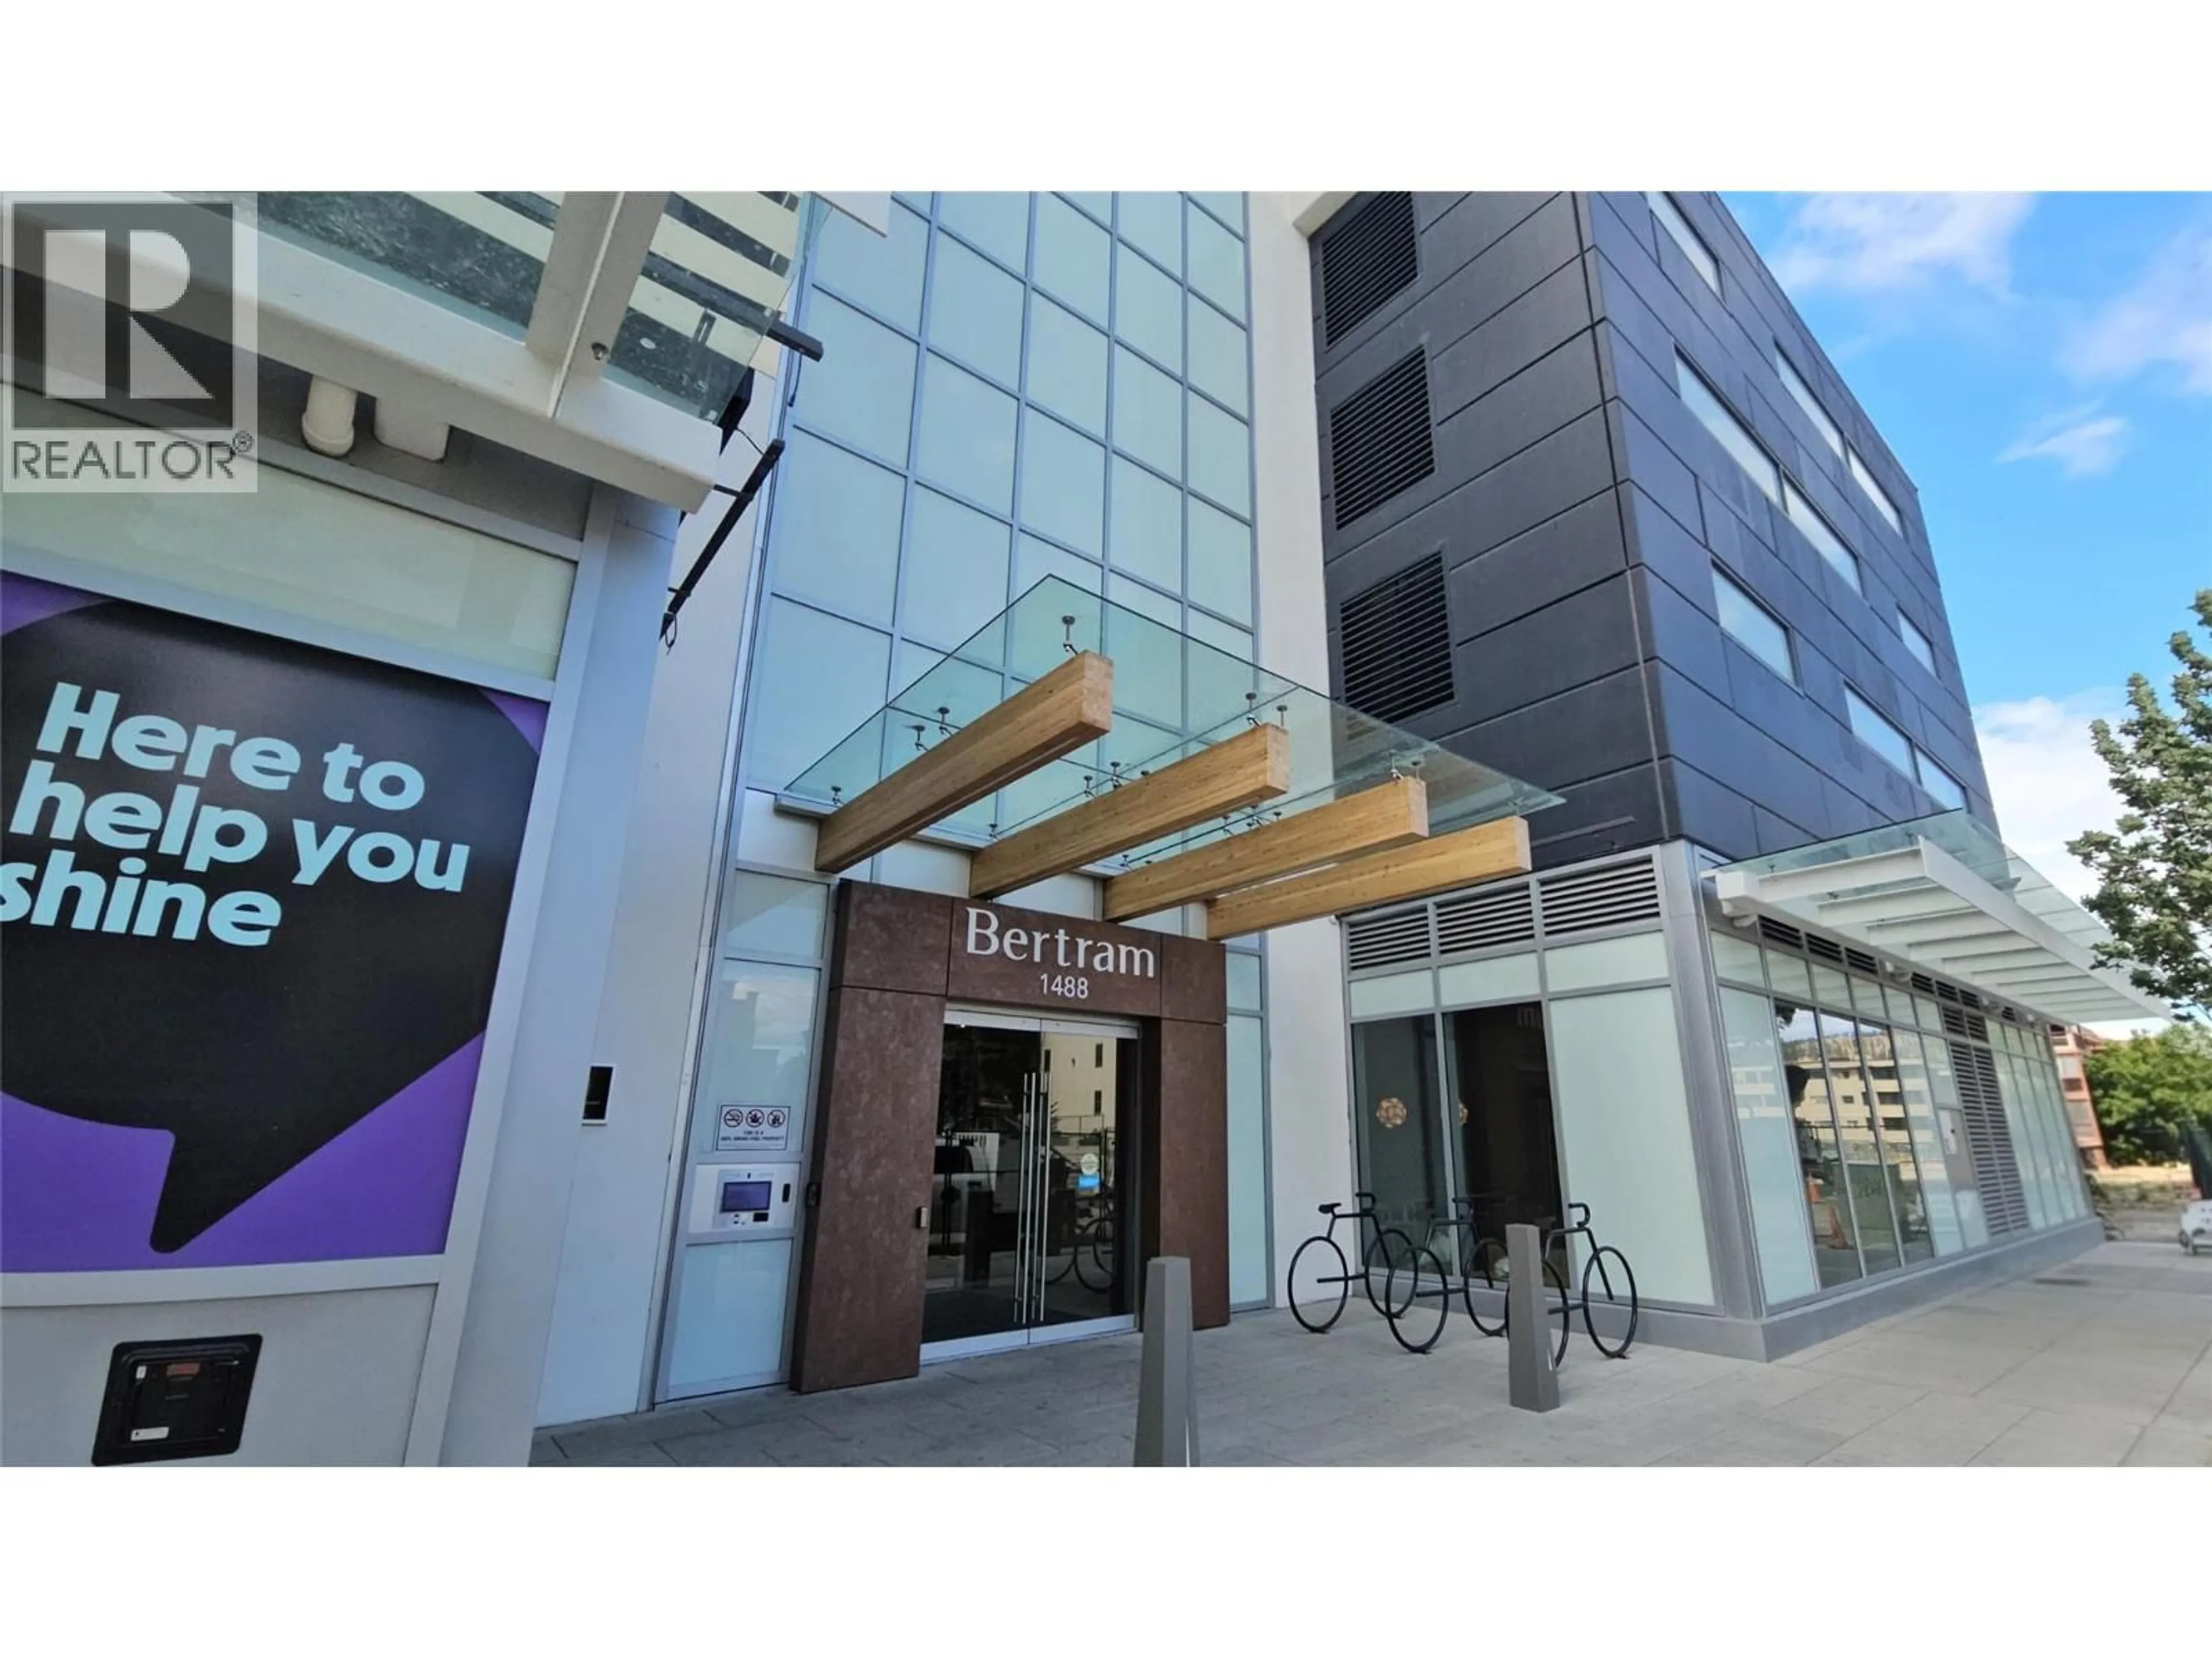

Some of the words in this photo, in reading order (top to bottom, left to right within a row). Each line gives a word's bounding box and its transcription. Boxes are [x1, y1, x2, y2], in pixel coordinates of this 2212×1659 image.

[37, 683, 301, 790] Here
[323, 743, 425, 810] to
[9, 760, 267, 872] help
[293, 819, 470, 892] you
[0, 849, 281, 945] shine
[967, 907, 1154, 978] Bertram
[1041, 973, 1089, 999] 1488
